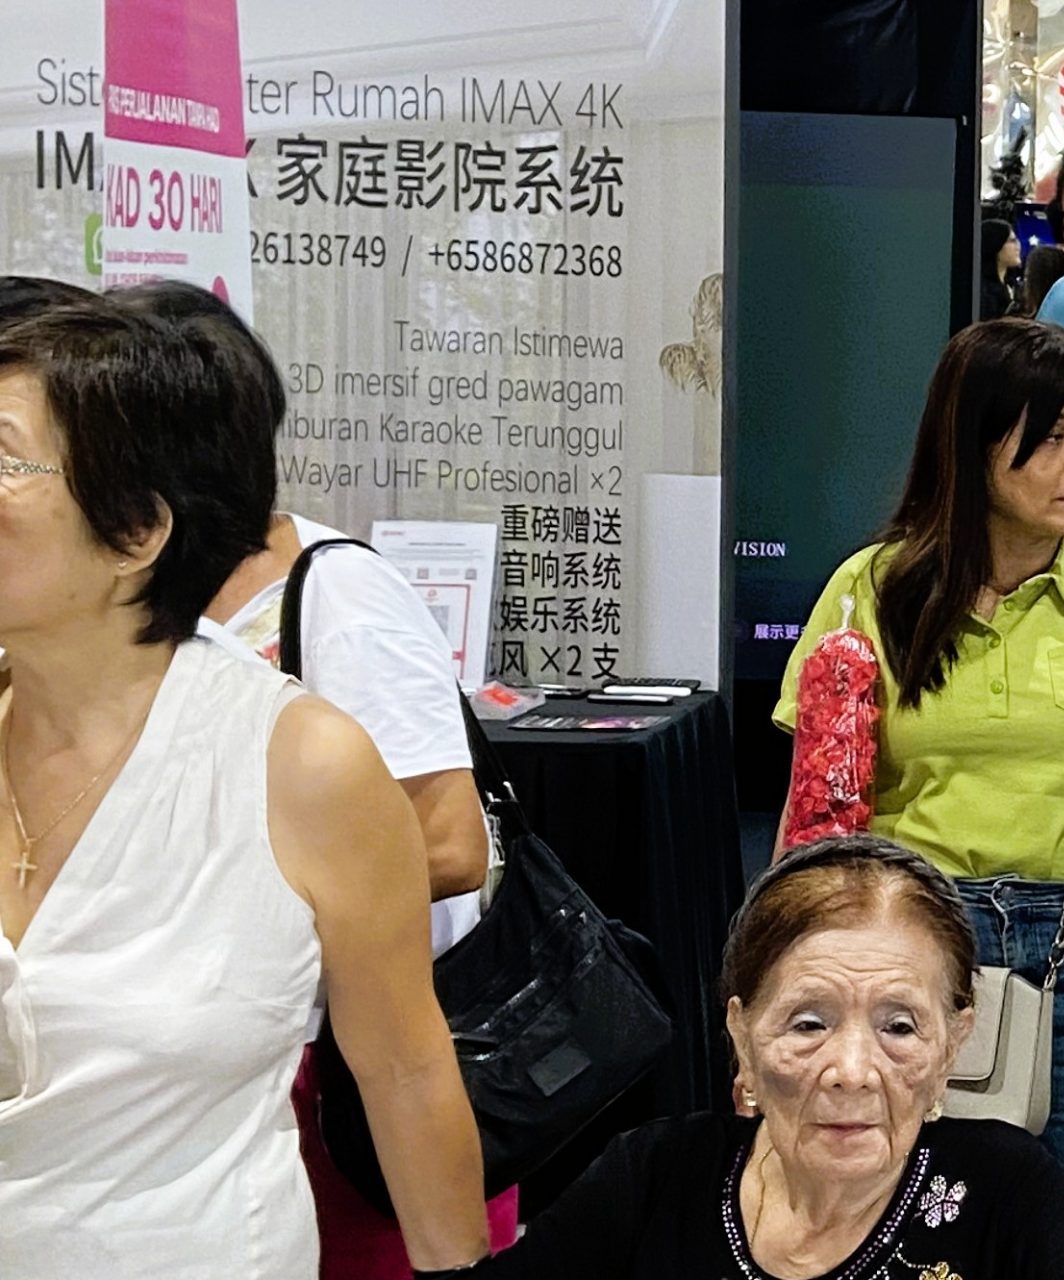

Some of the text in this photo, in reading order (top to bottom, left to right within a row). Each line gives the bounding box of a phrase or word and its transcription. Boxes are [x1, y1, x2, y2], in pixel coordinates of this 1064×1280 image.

[37, 58, 101, 107] Sist
[246, 73, 298, 115] ter
[313, 70, 444, 121] Rumah
[462, 77, 563, 126] IMAX
[575, 83, 624, 129] 4K
[36, 130, 104, 192] IM
[276, 132, 624, 218] 家庭影院系统
[106, 163, 141, 229] KAD
[148, 168, 184, 232] 30
[190, 173, 223, 234] HARI
[250, 231, 387, 269] 26138749
[428, 239, 623, 278] +6586872368
[394, 320, 624, 360] Tawaran Istimewa
[288, 363, 624, 411] 3D imersif gred pawagam
[280, 409, 623, 457] iburan Karaoke Terunggul
[281, 455, 363, 494] Wayar
[373, 457, 428, 489] UHF
[438, 460, 577, 495] Profesional
[501, 504, 622, 545] 重磅赠送
[501, 549, 621, 590] 音响系统
[495, 594, 621, 635] 娱乐系统
